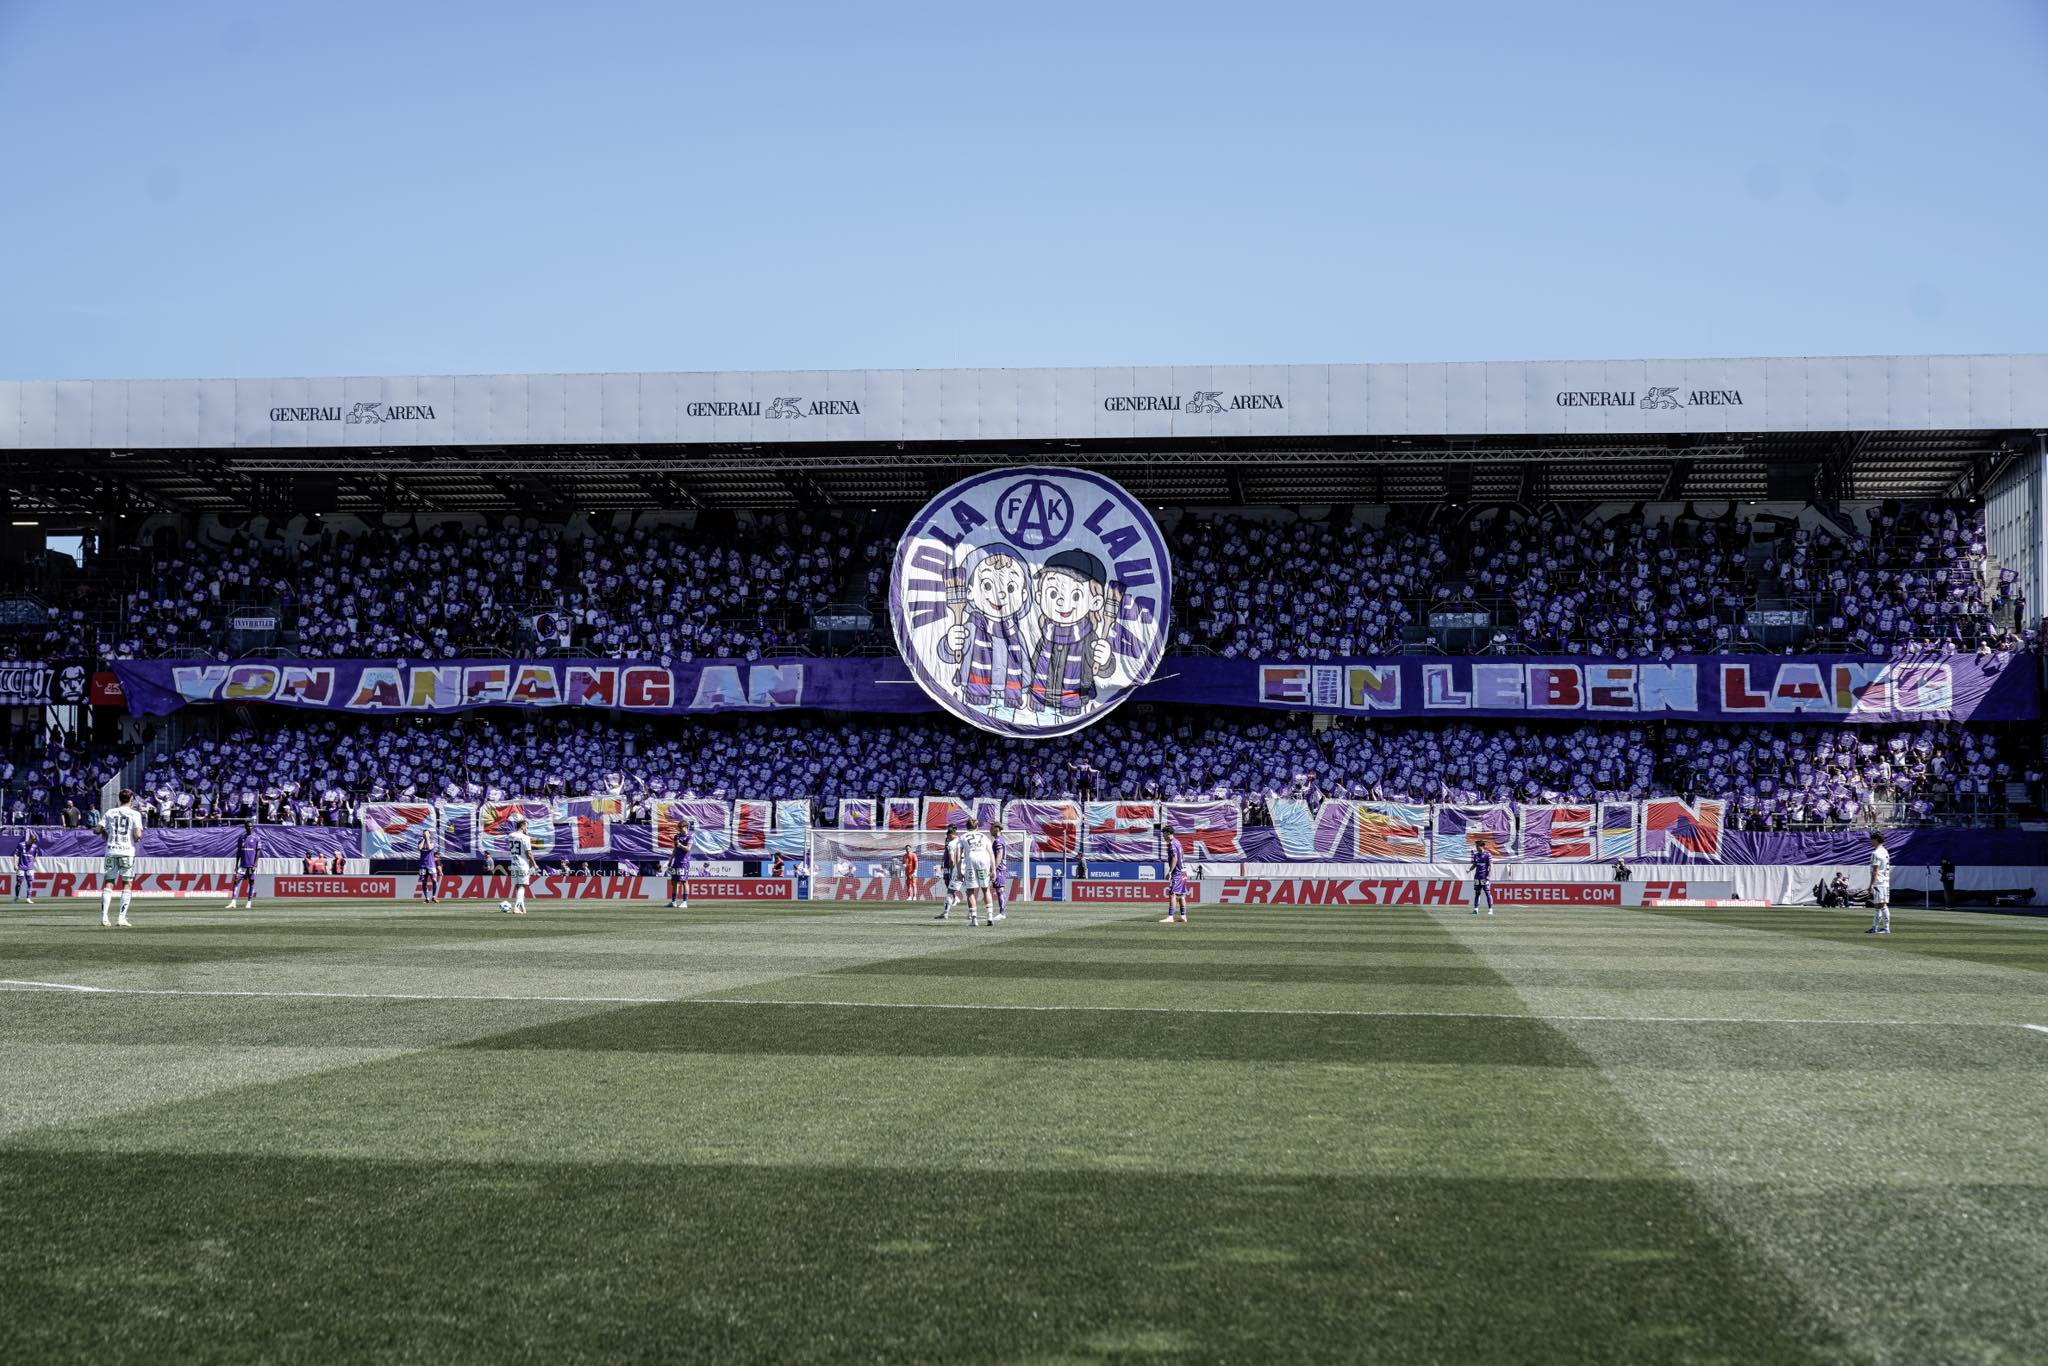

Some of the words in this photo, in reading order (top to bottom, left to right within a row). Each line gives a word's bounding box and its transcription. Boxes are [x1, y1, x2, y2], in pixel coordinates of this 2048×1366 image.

[687, 402, 761, 416] GENERALI
[808, 400, 861, 415] ARENA
[1104, 396, 1181, 411] GENERALI
[1229, 394, 1284, 409] ARENA
[1556, 391, 1636, 407] GENERALI
[1687, 390, 1743, 405] ARENA
[269, 407, 342, 421] GENERALI
[385, 405, 436, 420] ARENA
[172, 664, 336, 706] VON
[346, 664, 676, 709] ANFANG
[690, 664, 804, 709] AN
[1258, 664, 1402, 711] EIN
[1422, 663, 1698, 713] LEBEN
[1264, 796, 1727, 863] VEREIN
[1219, 880, 1470, 904] FRANKSTAHL
